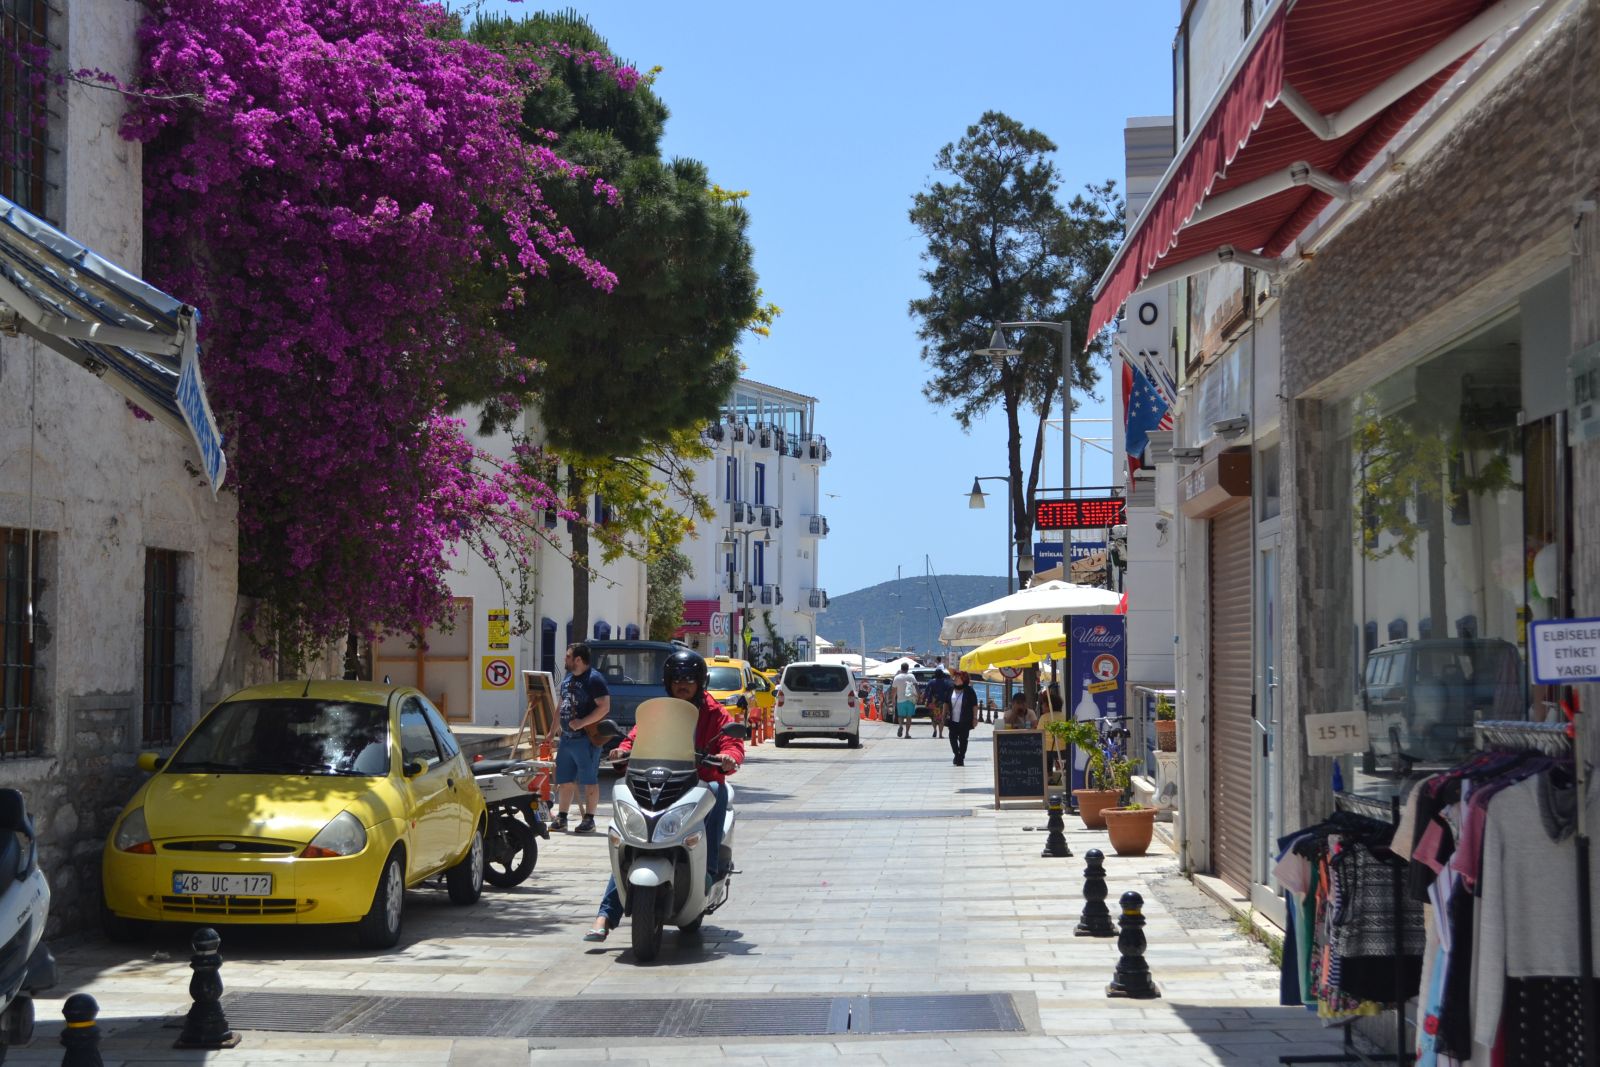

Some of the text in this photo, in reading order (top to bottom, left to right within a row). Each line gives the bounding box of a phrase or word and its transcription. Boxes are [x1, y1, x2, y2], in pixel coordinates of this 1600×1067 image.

[1554, 645, 1597, 659] ETİKET
[1556, 664, 1597, 676] YARISI
[1318, 724, 1361, 740] 15 TL
[182, 875, 199, 892] 48
[212, 876, 229, 893] UC
